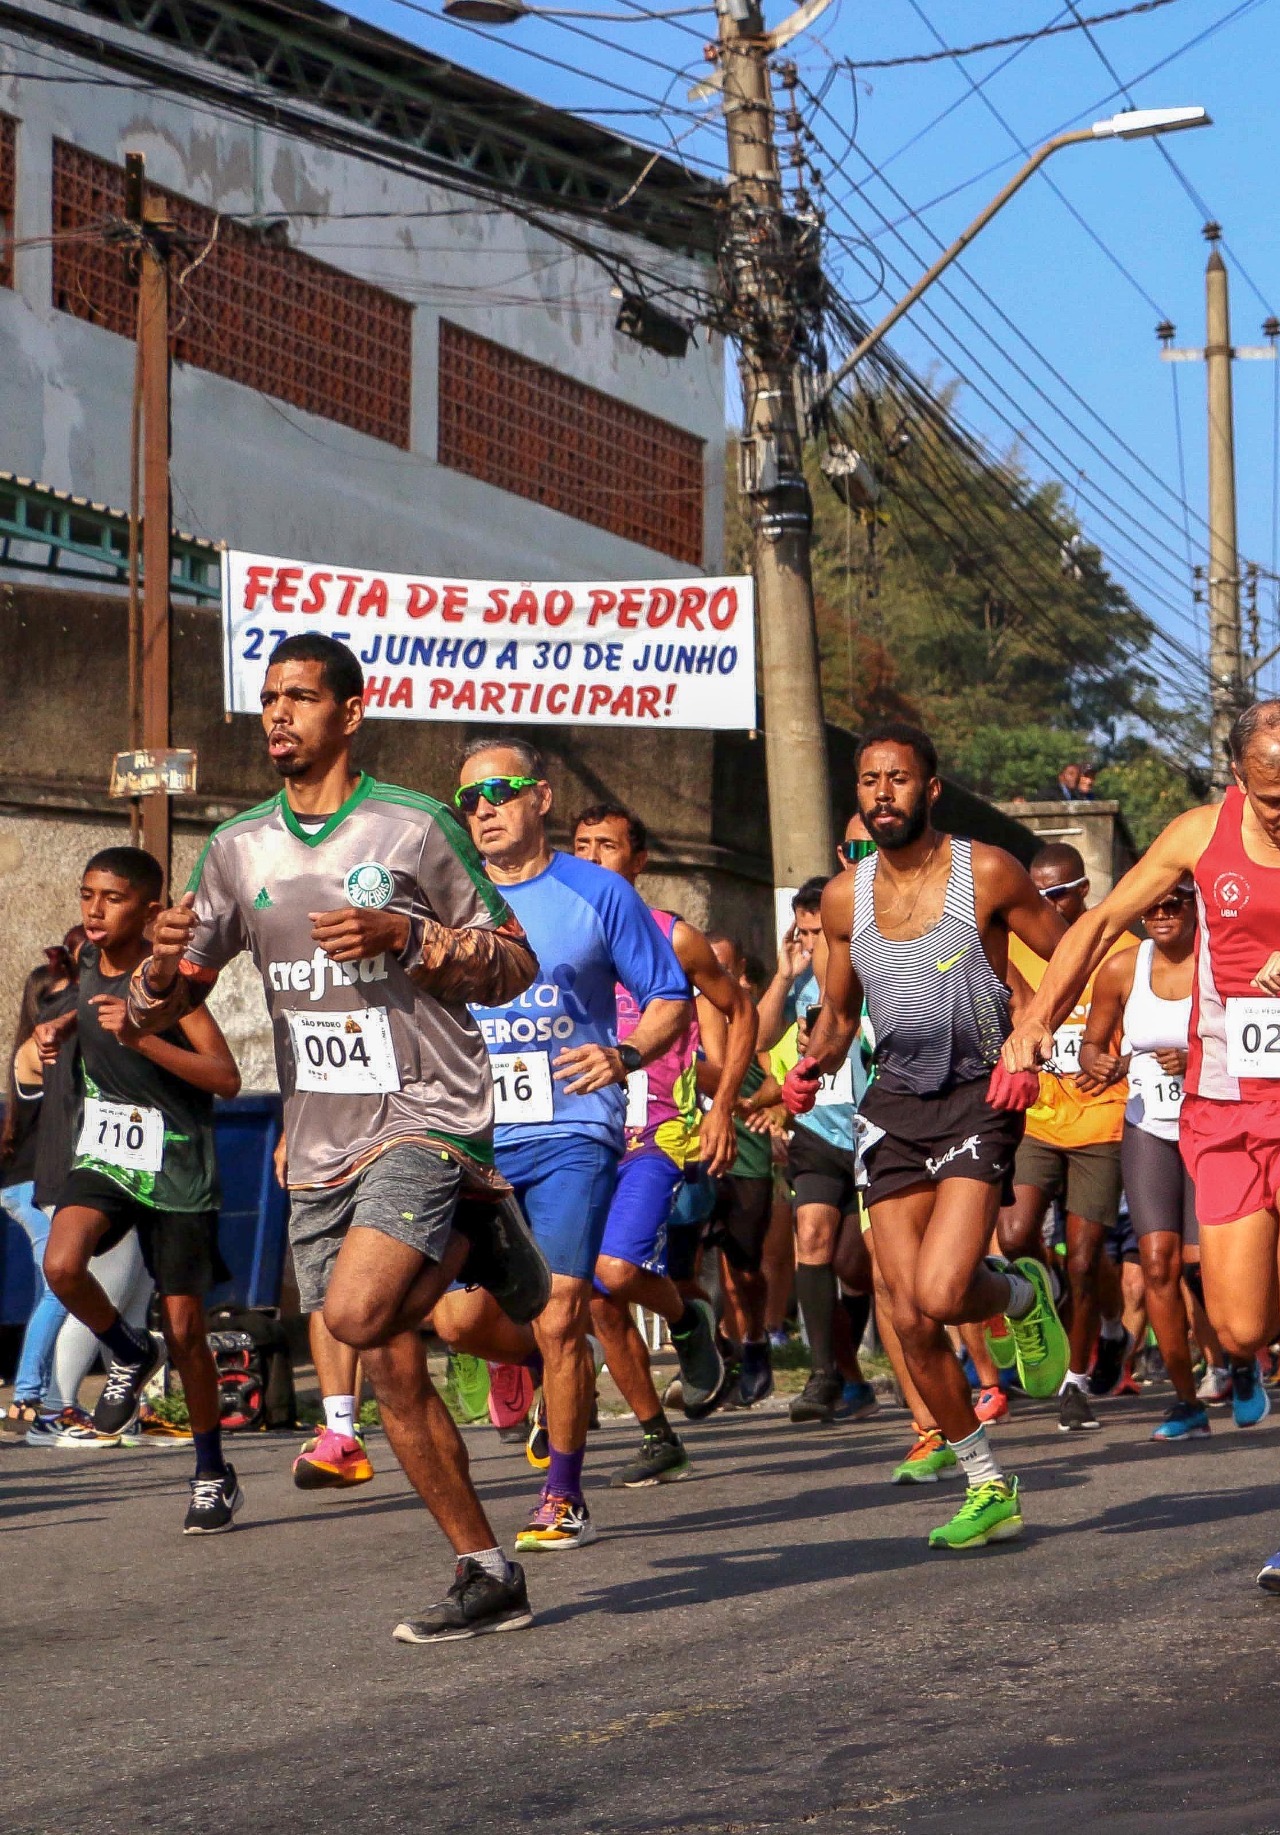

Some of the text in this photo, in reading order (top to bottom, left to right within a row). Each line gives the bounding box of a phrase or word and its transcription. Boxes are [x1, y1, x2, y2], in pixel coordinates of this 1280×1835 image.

[244, 566, 739, 631] FESTA DE SÃO PEDRO
[361, 634, 487, 671] JUNHO
[496, 641, 518, 671] A
[533, 641, 571, 671] 30
[583, 642, 624, 671] DE
[633, 643, 738, 676] JUNHO
[429, 678, 677, 718] PARTICIPAR!
[348, 882, 390, 908] PALMEIRAS
[1220, 909, 1238, 918] UBM
[268, 946, 388, 1001] crefisa
[301, 1017, 342, 1029] SÃO PEDRO
[477, 1015, 574, 1044] EROSO
[305, 1035, 371, 1068] 004
[1053, 1039, 1083, 1058] 14
[493, 1075, 532, 1102] 16
[1155, 1082, 1181, 1102] 18
[98, 1120, 144, 1150] 110
